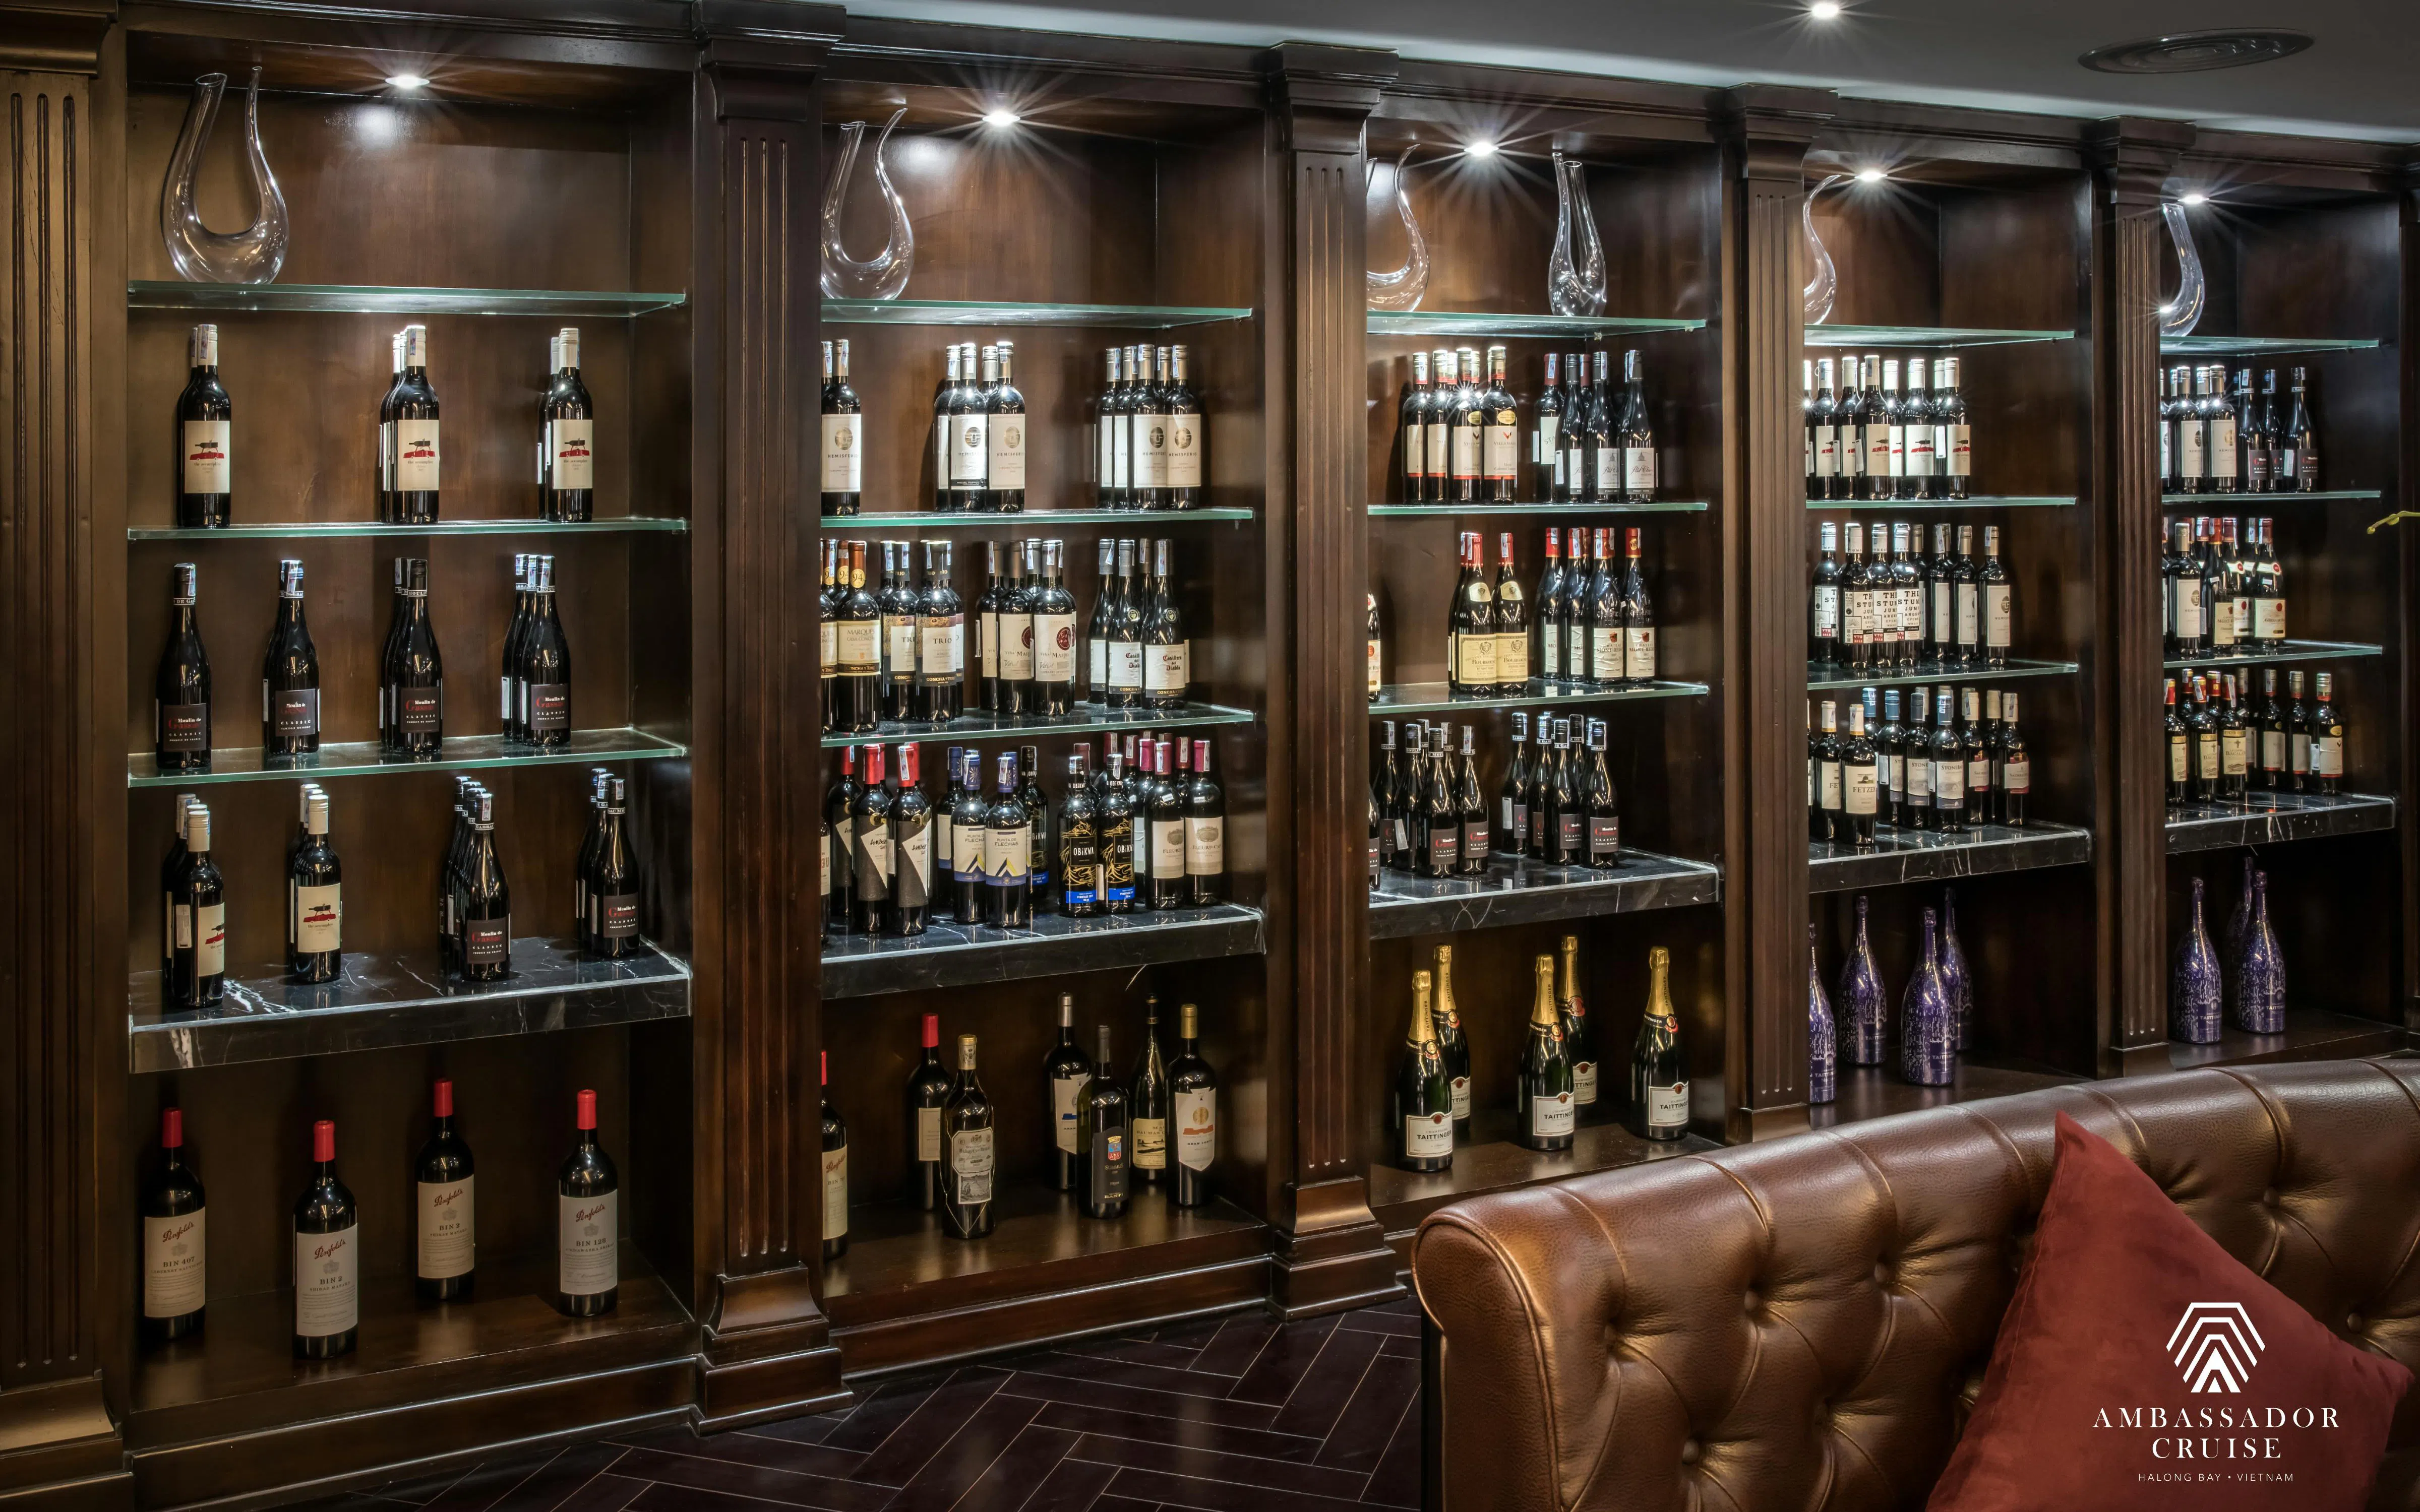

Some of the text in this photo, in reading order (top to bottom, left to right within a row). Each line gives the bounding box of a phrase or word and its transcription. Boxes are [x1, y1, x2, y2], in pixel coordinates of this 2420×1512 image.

[1417, 1130, 1452, 1140] TAITTINGER
[434, 1188, 464, 1208] Penfolds
[576, 1203, 606, 1222] Penfolds
[163, 1221, 195, 1243] Penfolds
[315, 1238, 346, 1260] Penfolds
[163, 1256, 196, 1268] BIN 407
